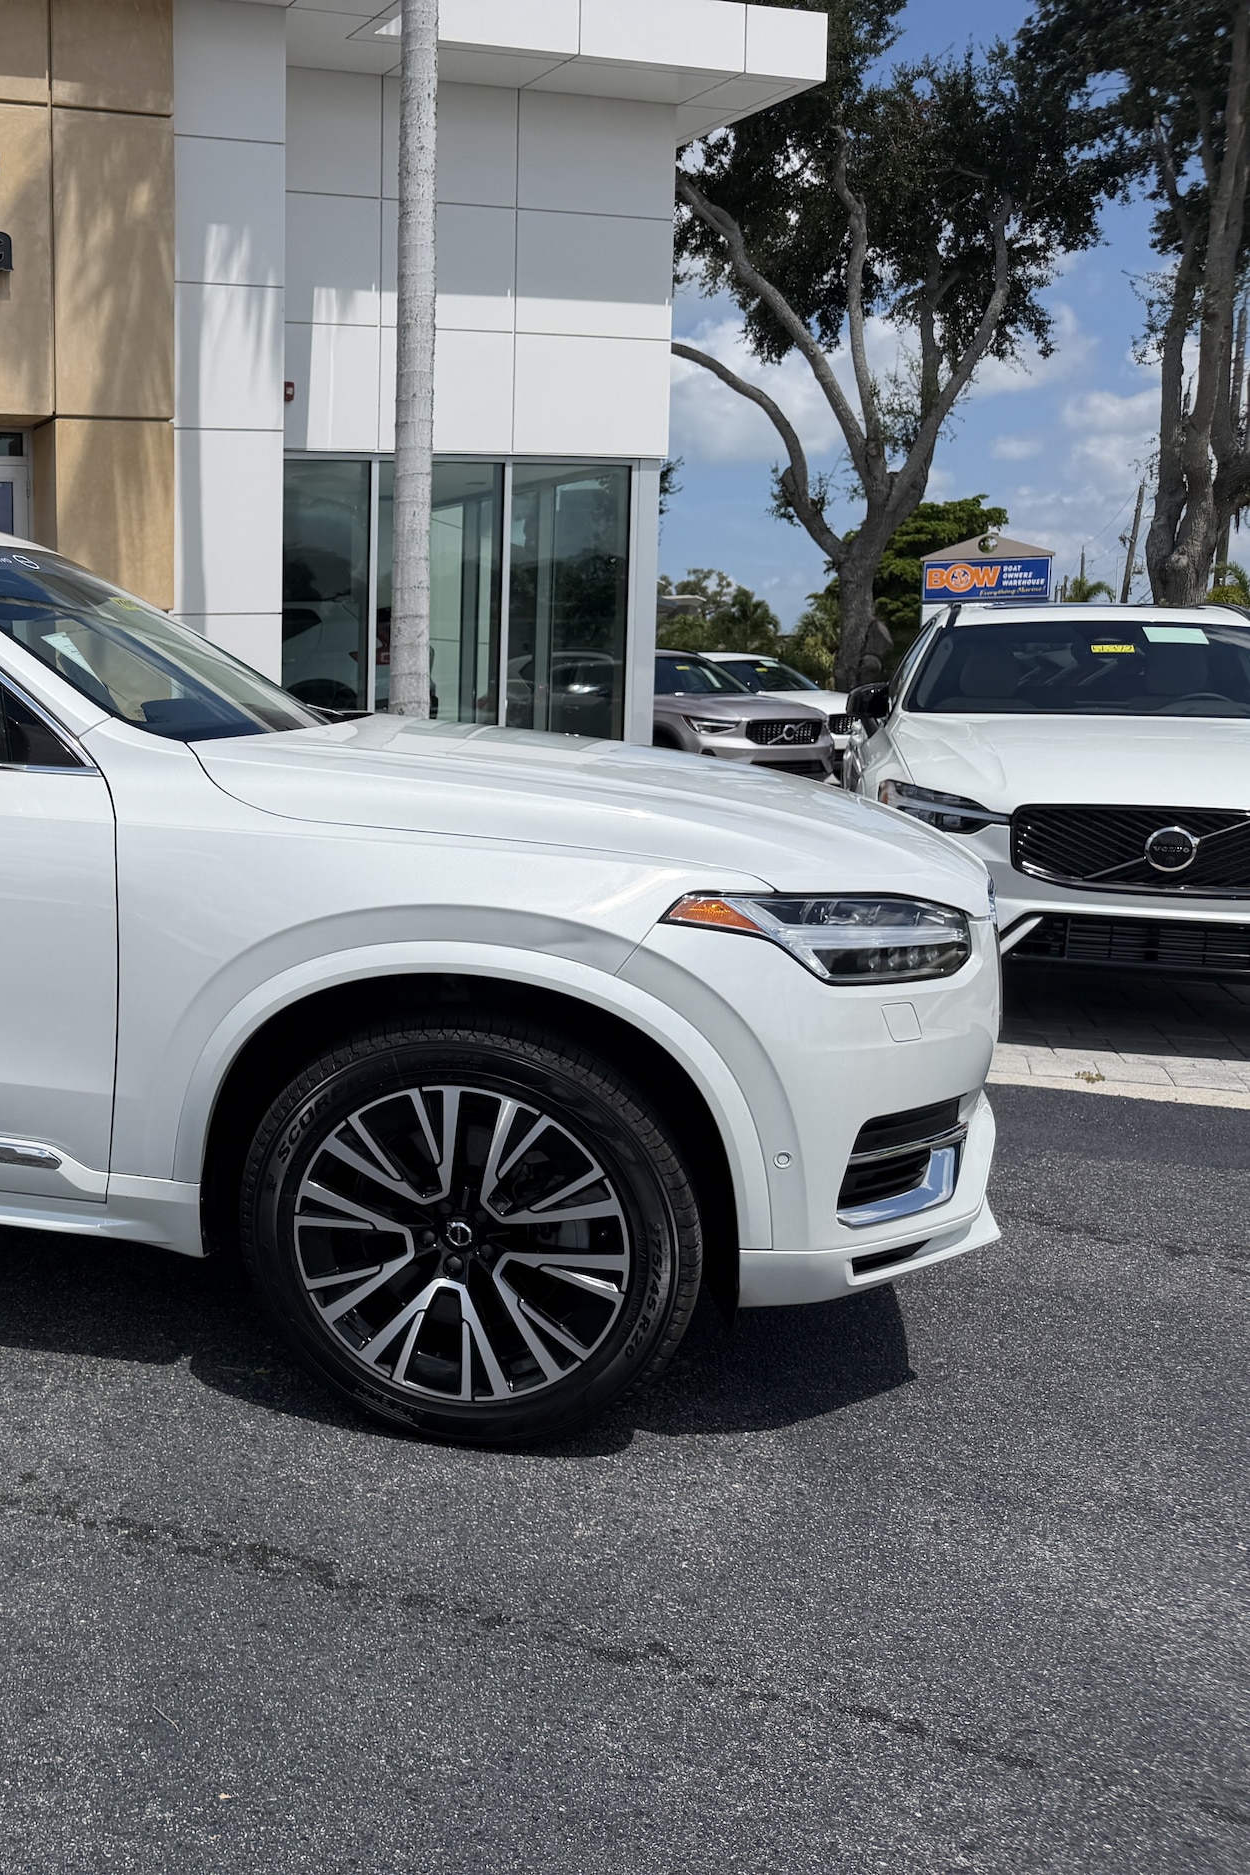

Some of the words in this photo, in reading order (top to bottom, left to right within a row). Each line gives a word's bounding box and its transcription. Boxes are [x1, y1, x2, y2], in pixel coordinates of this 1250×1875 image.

[926, 563, 1001, 593] BOW
[1002, 571, 1033, 579] OWNERS
[1002, 578, 1045, 586] WAREHOUSE
[979, 588, 1016, 597] Everything
